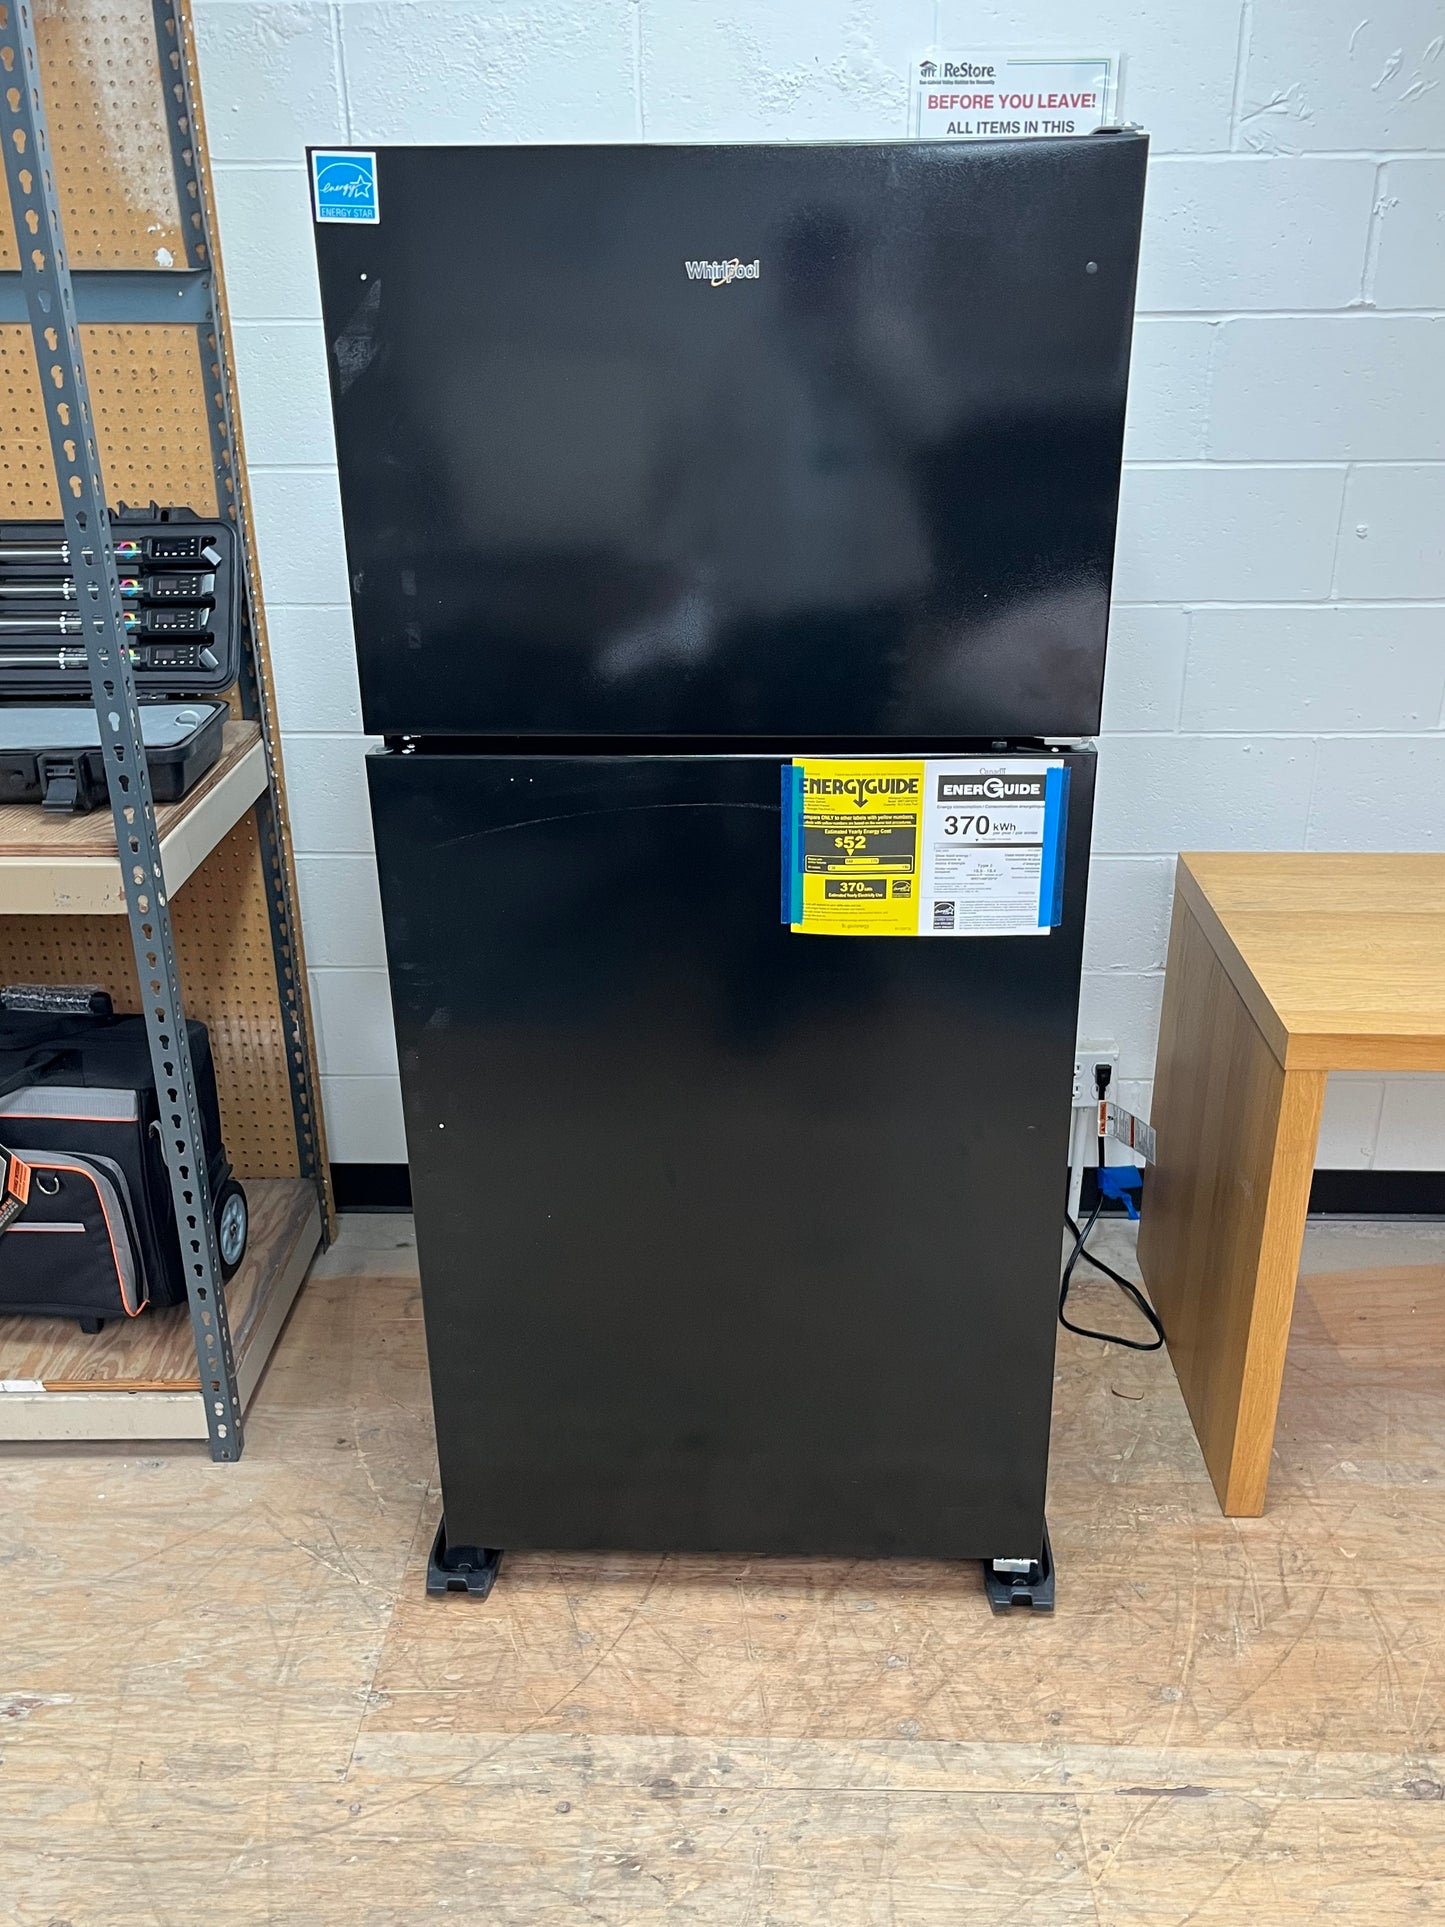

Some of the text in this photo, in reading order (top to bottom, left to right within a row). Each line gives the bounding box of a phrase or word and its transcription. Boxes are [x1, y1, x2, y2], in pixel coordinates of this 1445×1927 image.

[944, 62, 995, 78] ReStore
[927, 93, 1096, 110] BEFORE YOU LEAVE!
[946, 120, 1075, 135] ALL ITEMS IN THIS
[321, 207, 374, 218] ENERGY STAR
[685, 259, 760, 284] Whirlpool
[943, 777, 1041, 799] ENERGUIDE
[944, 815, 1016, 835] 370 kWh
[834, 835, 866, 849] $52
[840, 882, 865, 892] 370
